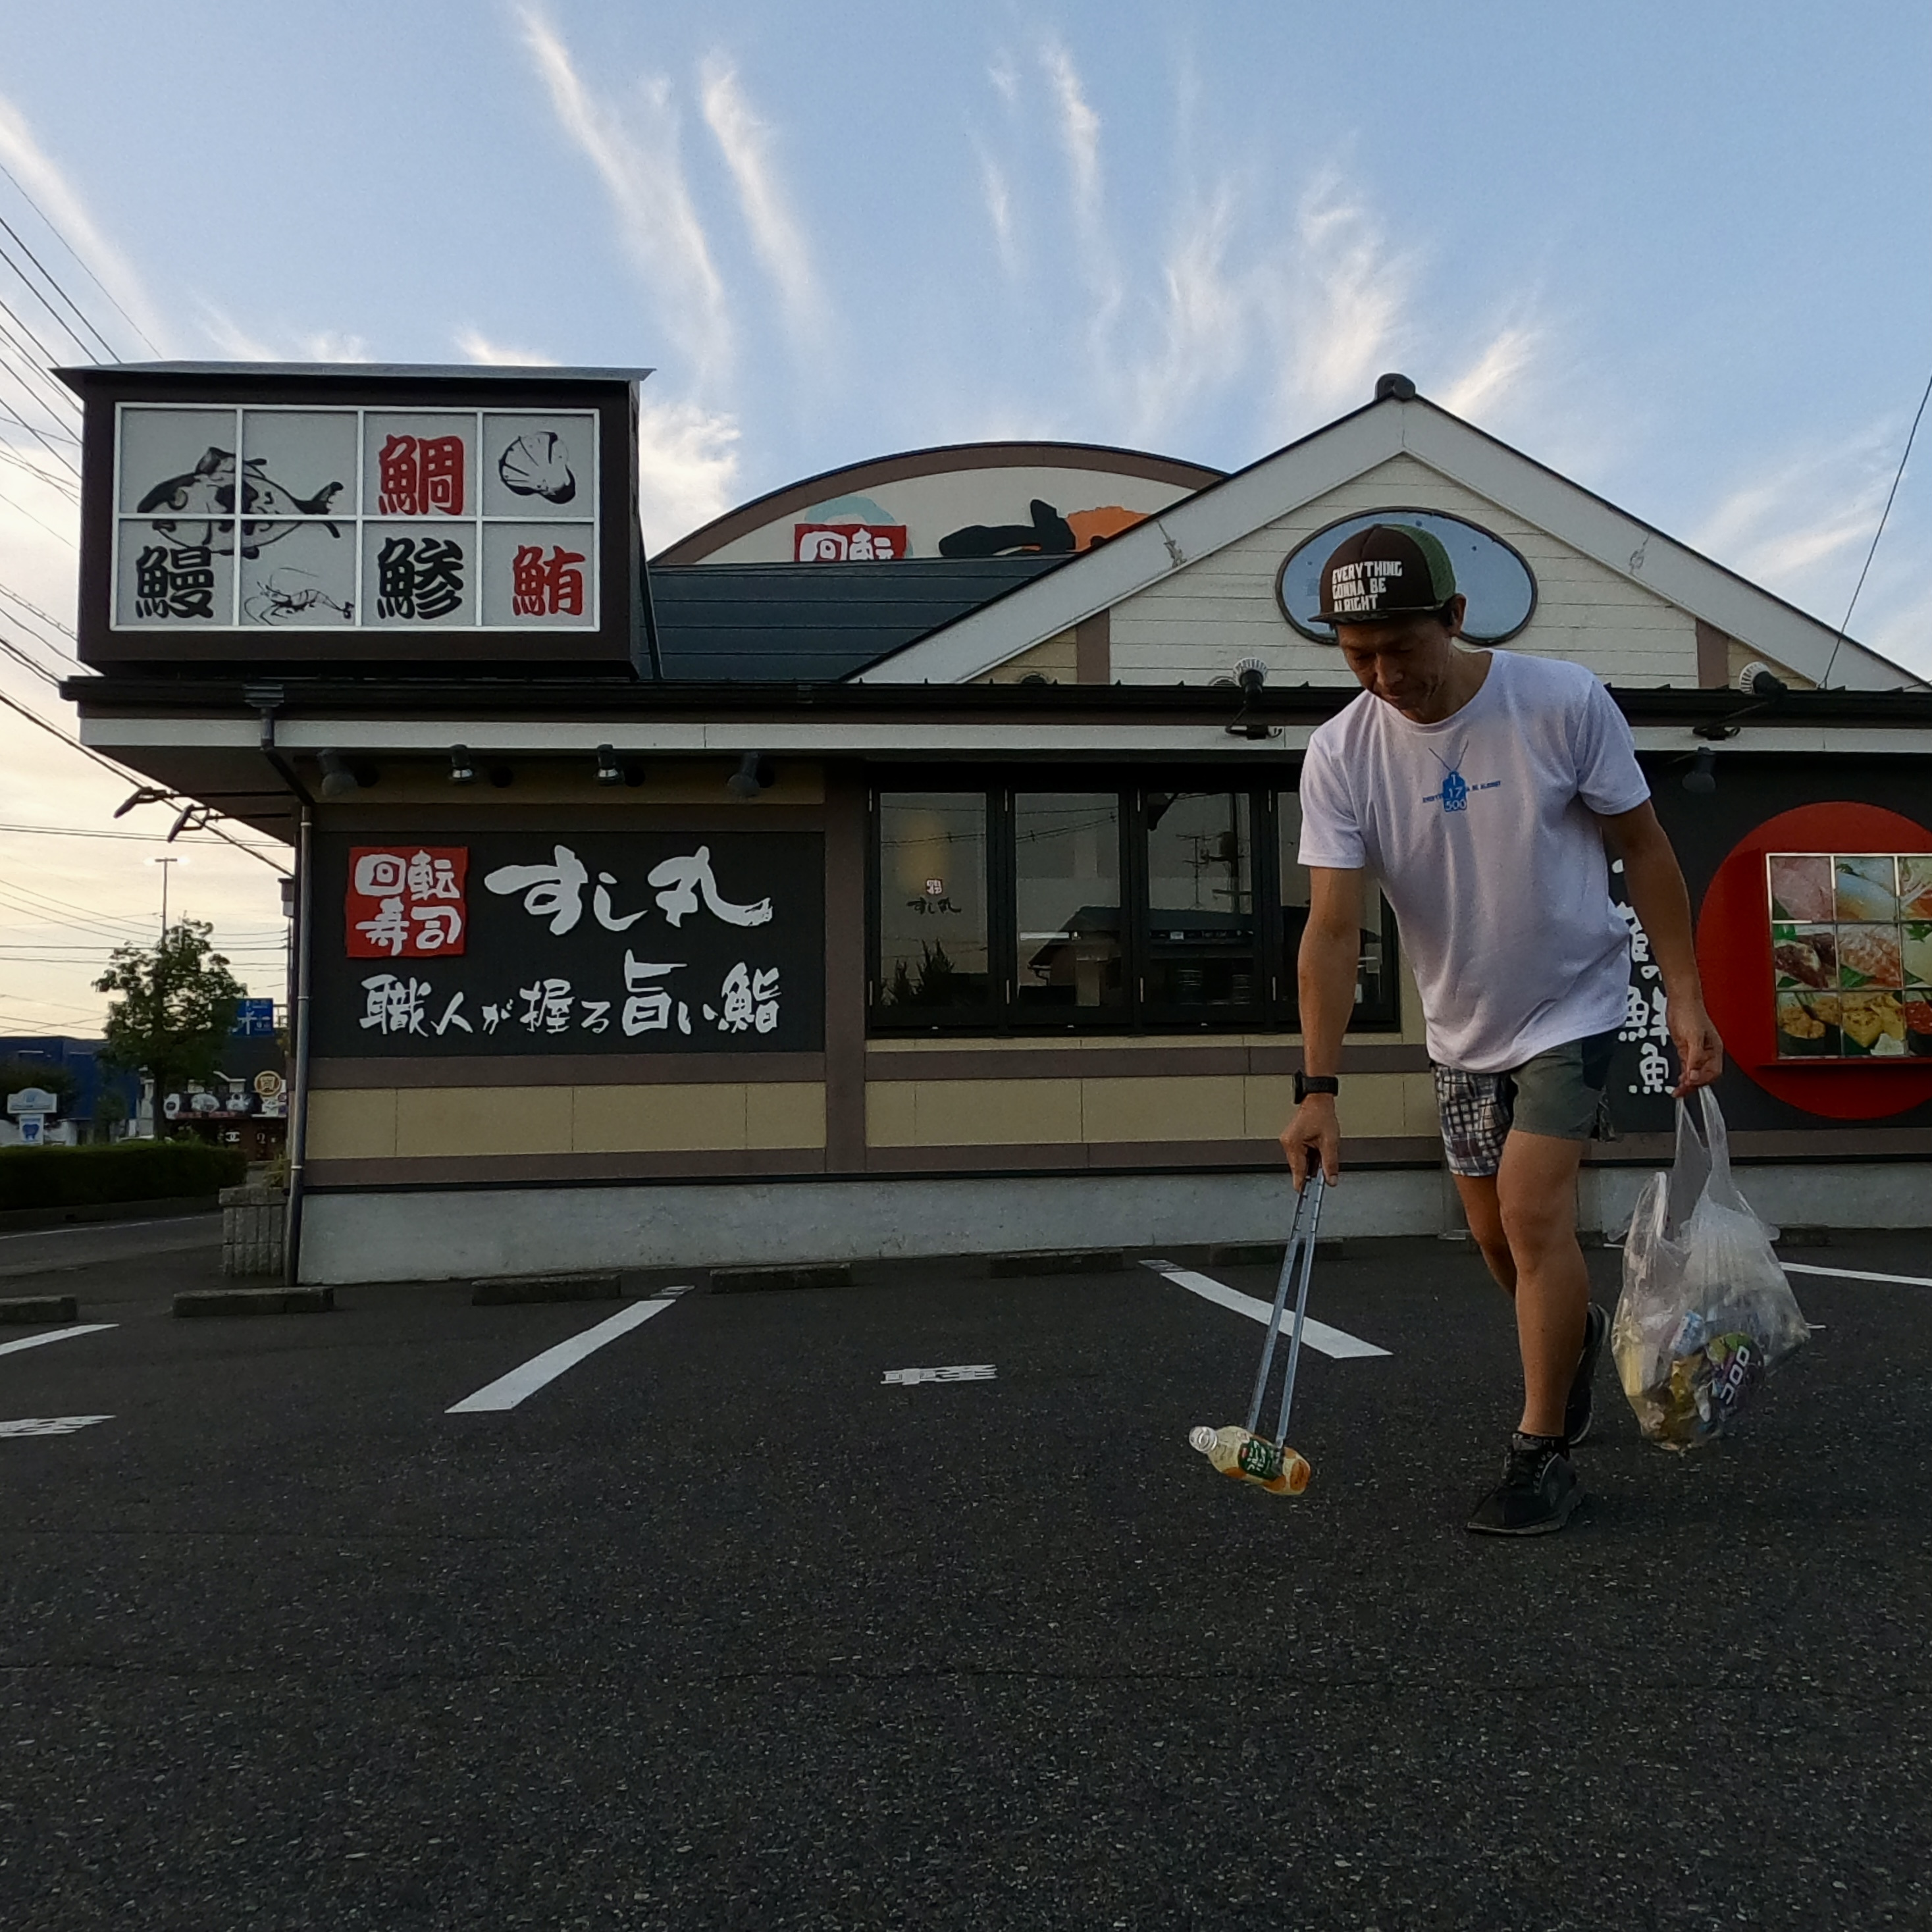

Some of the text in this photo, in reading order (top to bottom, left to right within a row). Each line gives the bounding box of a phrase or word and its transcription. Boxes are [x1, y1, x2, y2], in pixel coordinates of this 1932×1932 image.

[378, 434, 464, 515] 鯛
[136, 546, 214, 619] 鰻
[511, 544, 585, 617] 鮪
[1332, 561, 1403, 585] EVERYTHING
[1332, 577, 1387, 600] GONNA BE
[1444, 798, 1467, 811] 500
[1448, 787, 1463, 798] 17
[355, 849, 460, 901] 回転
[355, 897, 461, 956] 寿司
[359, 949, 781, 1037] 職人が握る旨い鮨
